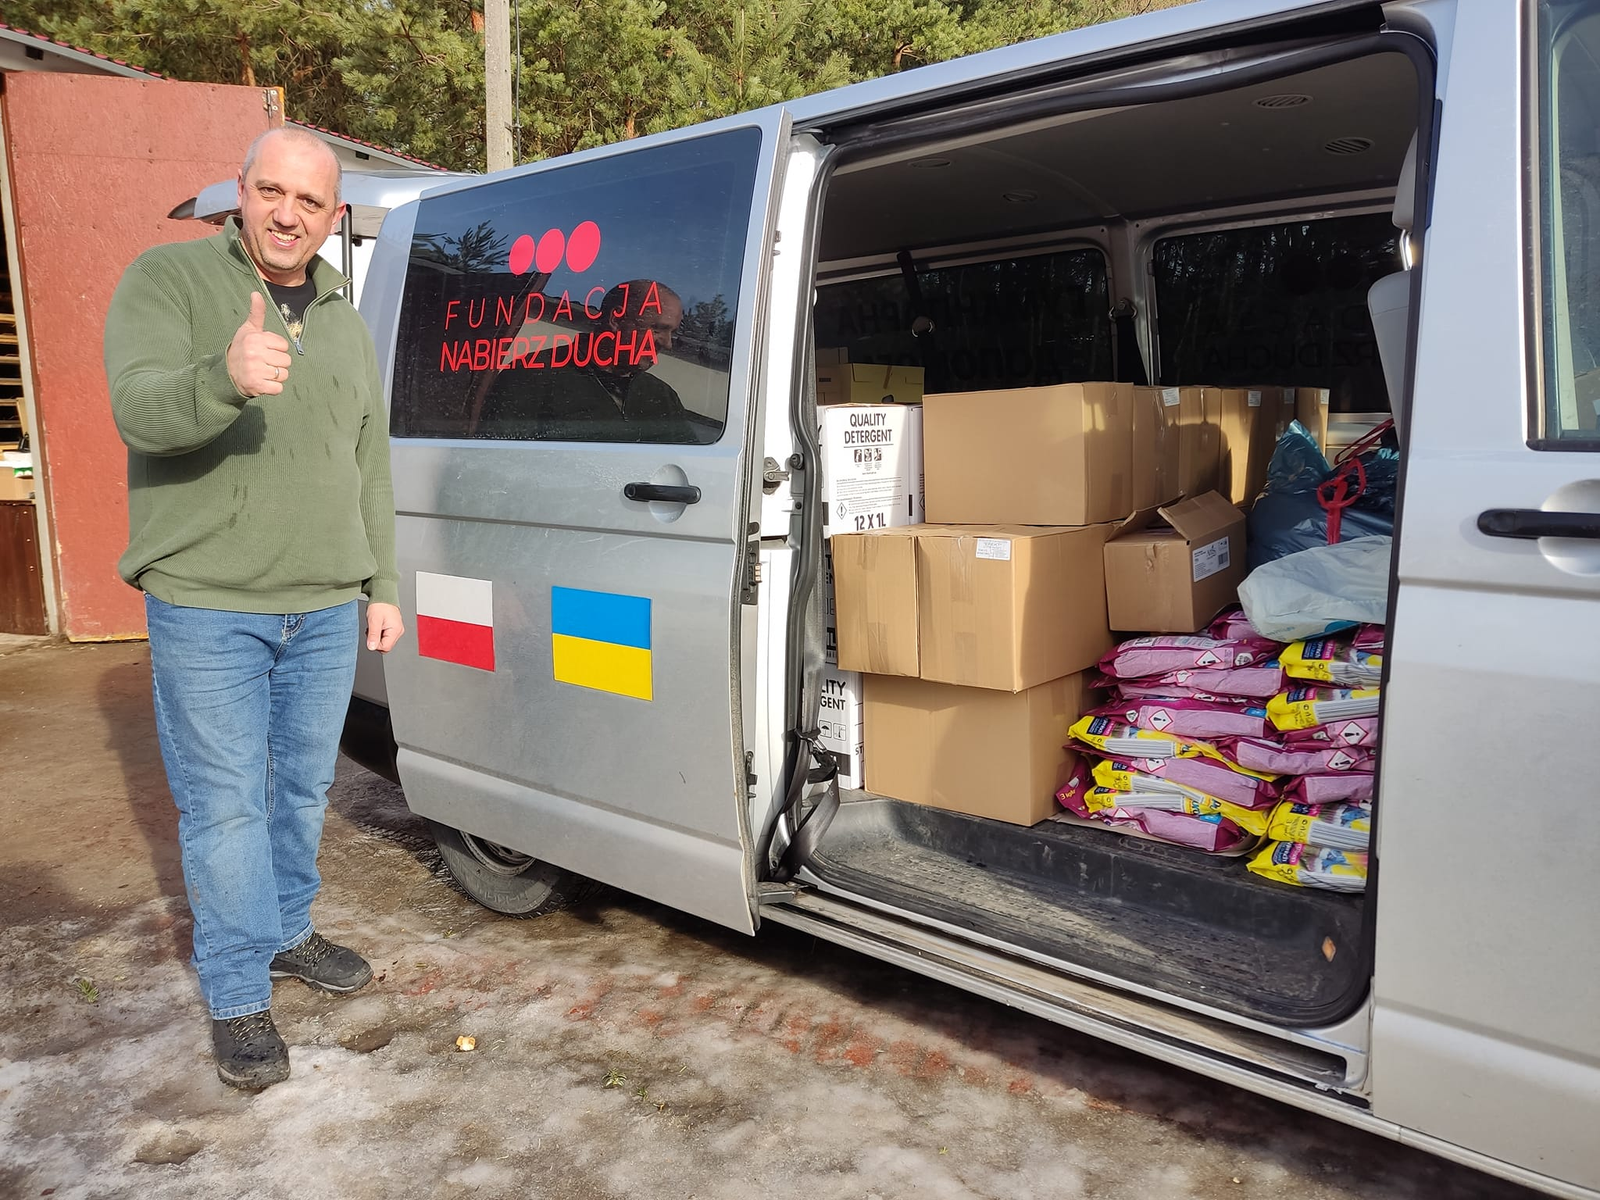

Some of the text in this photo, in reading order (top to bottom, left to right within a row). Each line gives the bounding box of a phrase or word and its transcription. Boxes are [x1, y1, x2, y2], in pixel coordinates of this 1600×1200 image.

[445, 281, 662, 330] FUNDACJA
[440, 329, 658, 372] NABIERZ DUCHA
[849, 413, 887, 428] QUALITY
[844, 429, 892, 444] DETERGENT
[855, 515, 865, 531] 12
[876, 512, 886, 527] 1L
